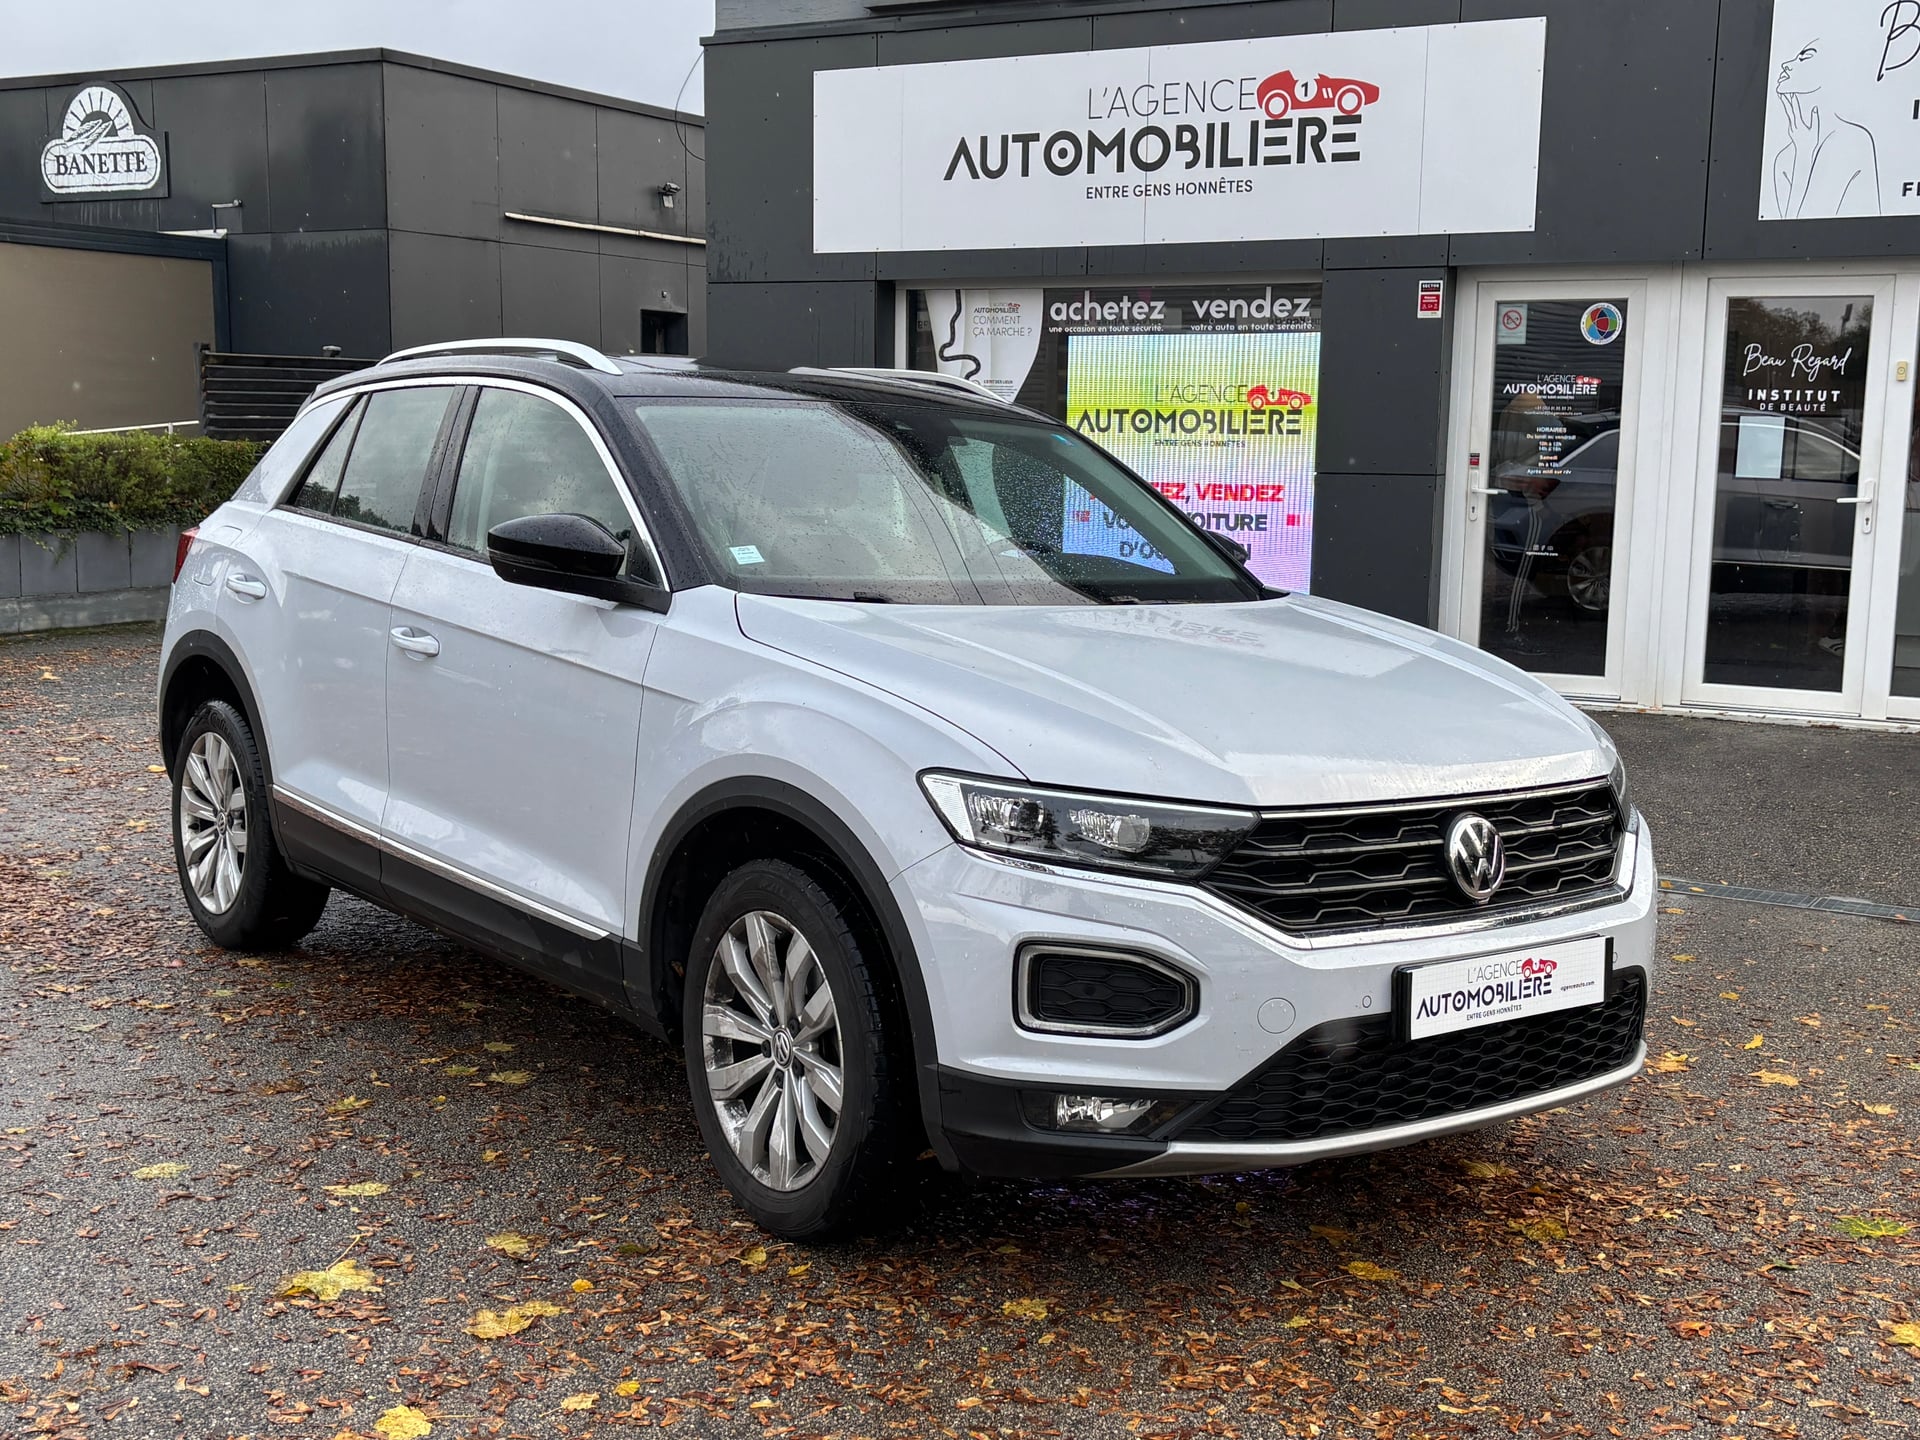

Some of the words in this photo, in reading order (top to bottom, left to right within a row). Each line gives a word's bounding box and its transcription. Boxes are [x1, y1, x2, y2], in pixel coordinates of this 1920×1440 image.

[1088, 76, 1257, 120] L'AGENCE
[55, 151, 148, 176] BANETTE
[1086, 185, 1129, 200] ENTRE
[1132, 184, 1171, 198] GENS
[1174, 177, 1253, 197] HONNÊTES
[1049, 289, 1166, 321] achetez
[1191, 286, 1312, 319] vendez
[972, 315, 1022, 325] COMMENT
[1064, 324, 1096, 333] occasion
[1215, 323, 1235, 331] auto
[972, 327, 985, 338] ÇA
[986, 326, 1025, 337] MARCHE
[1027, 327, 1033, 336] ?
[1742, 343, 1786, 377] Beau
[1790, 343, 1852, 382] Regard
[1537, 374, 1576, 383] L'AGENCE
[1155, 384, 1248, 403] L'AGENCE
[1748, 389, 1841, 402] INSTITUT
[1759, 402, 1774, 411] DE
[1780, 402, 1827, 412] BEAUTÉ
[1154, 438, 1179, 448] ENTRE
[1180, 439, 1202, 448] GENS
[1203, 438, 1247, 448] HONNÊTES
[1194, 483, 1285, 502] VENDEZ
[1467, 959, 1523, 984] L'AGENCE
[1466, 1013, 1482, 1021] ENTRE
[1482, 1010, 1496, 1018] GENS
[1496, 1004, 1523, 1016] HONNÊTES
